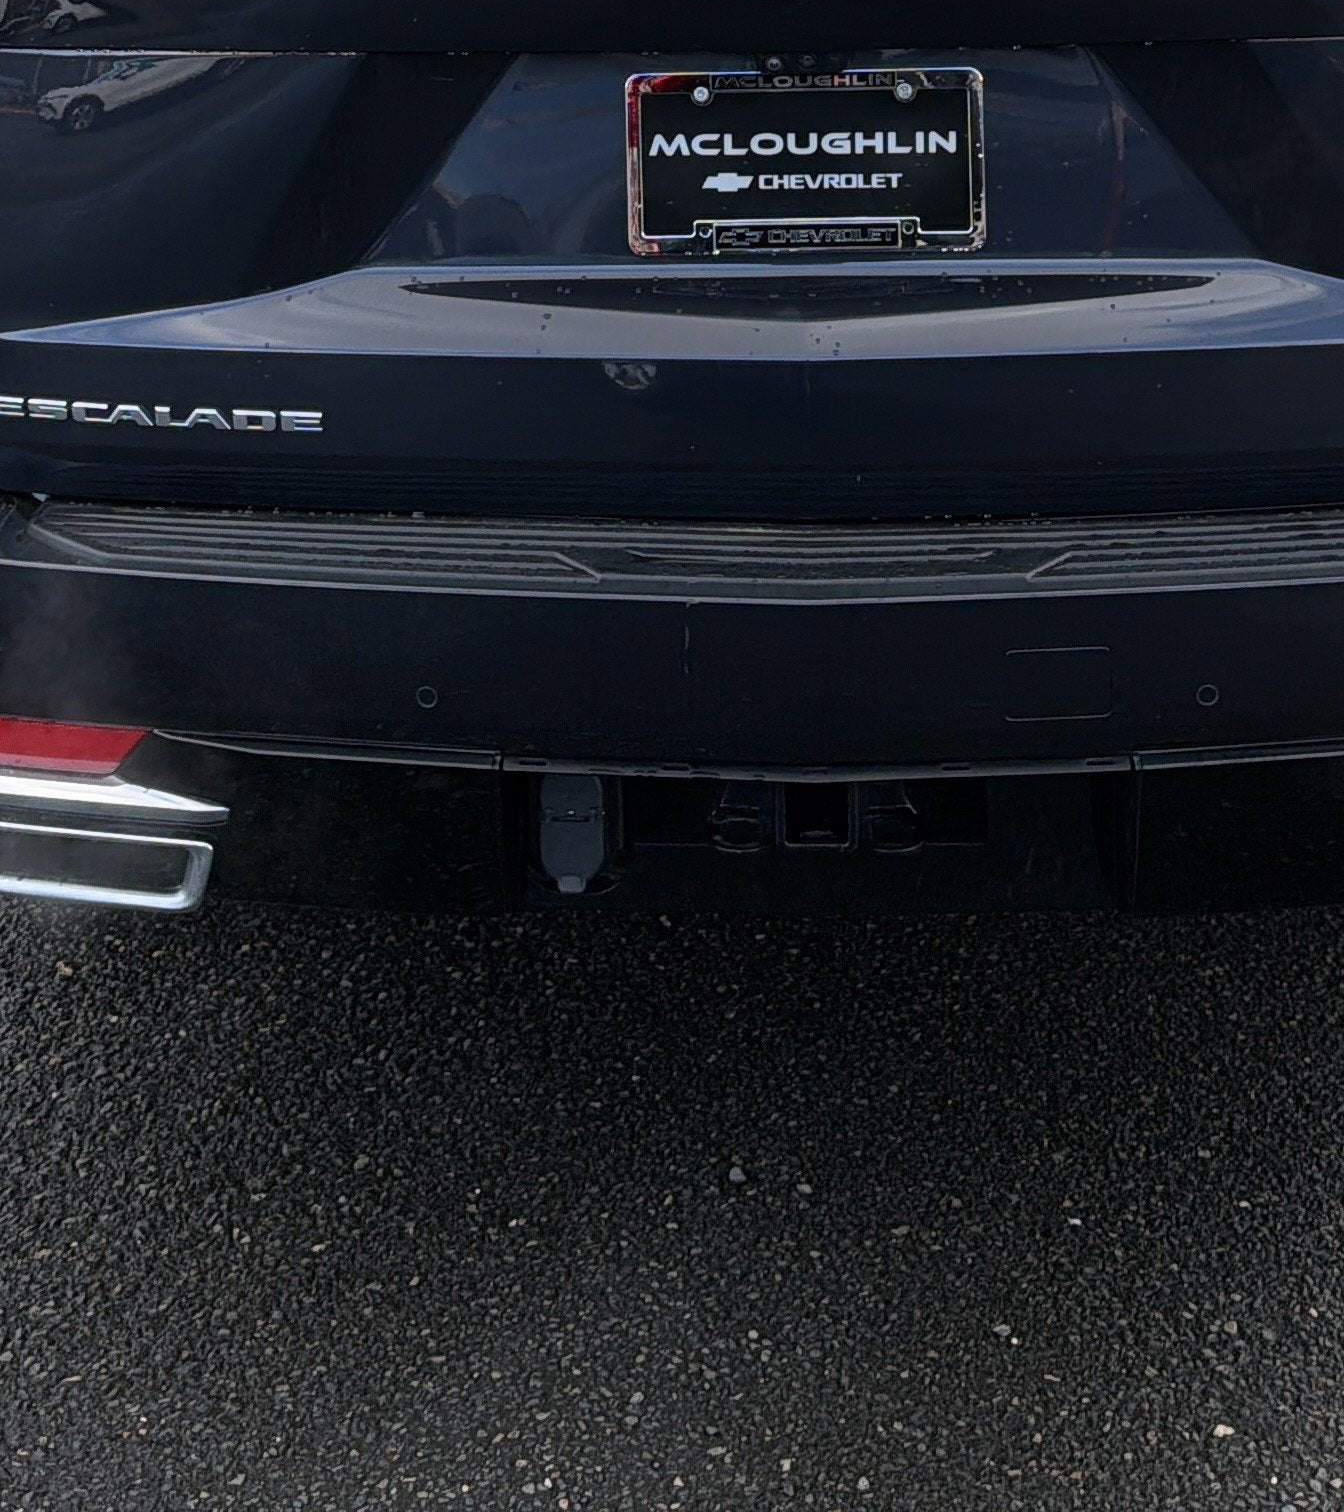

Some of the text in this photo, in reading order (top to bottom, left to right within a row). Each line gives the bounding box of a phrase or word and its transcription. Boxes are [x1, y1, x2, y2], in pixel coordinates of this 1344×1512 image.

[714, 73, 893, 89] MCLOUGHLIN
[648, 130, 958, 157] MCLOUGHLIN
[758, 173, 903, 190] CHEVROLET
[767, 227, 897, 244] CHEVROLET
